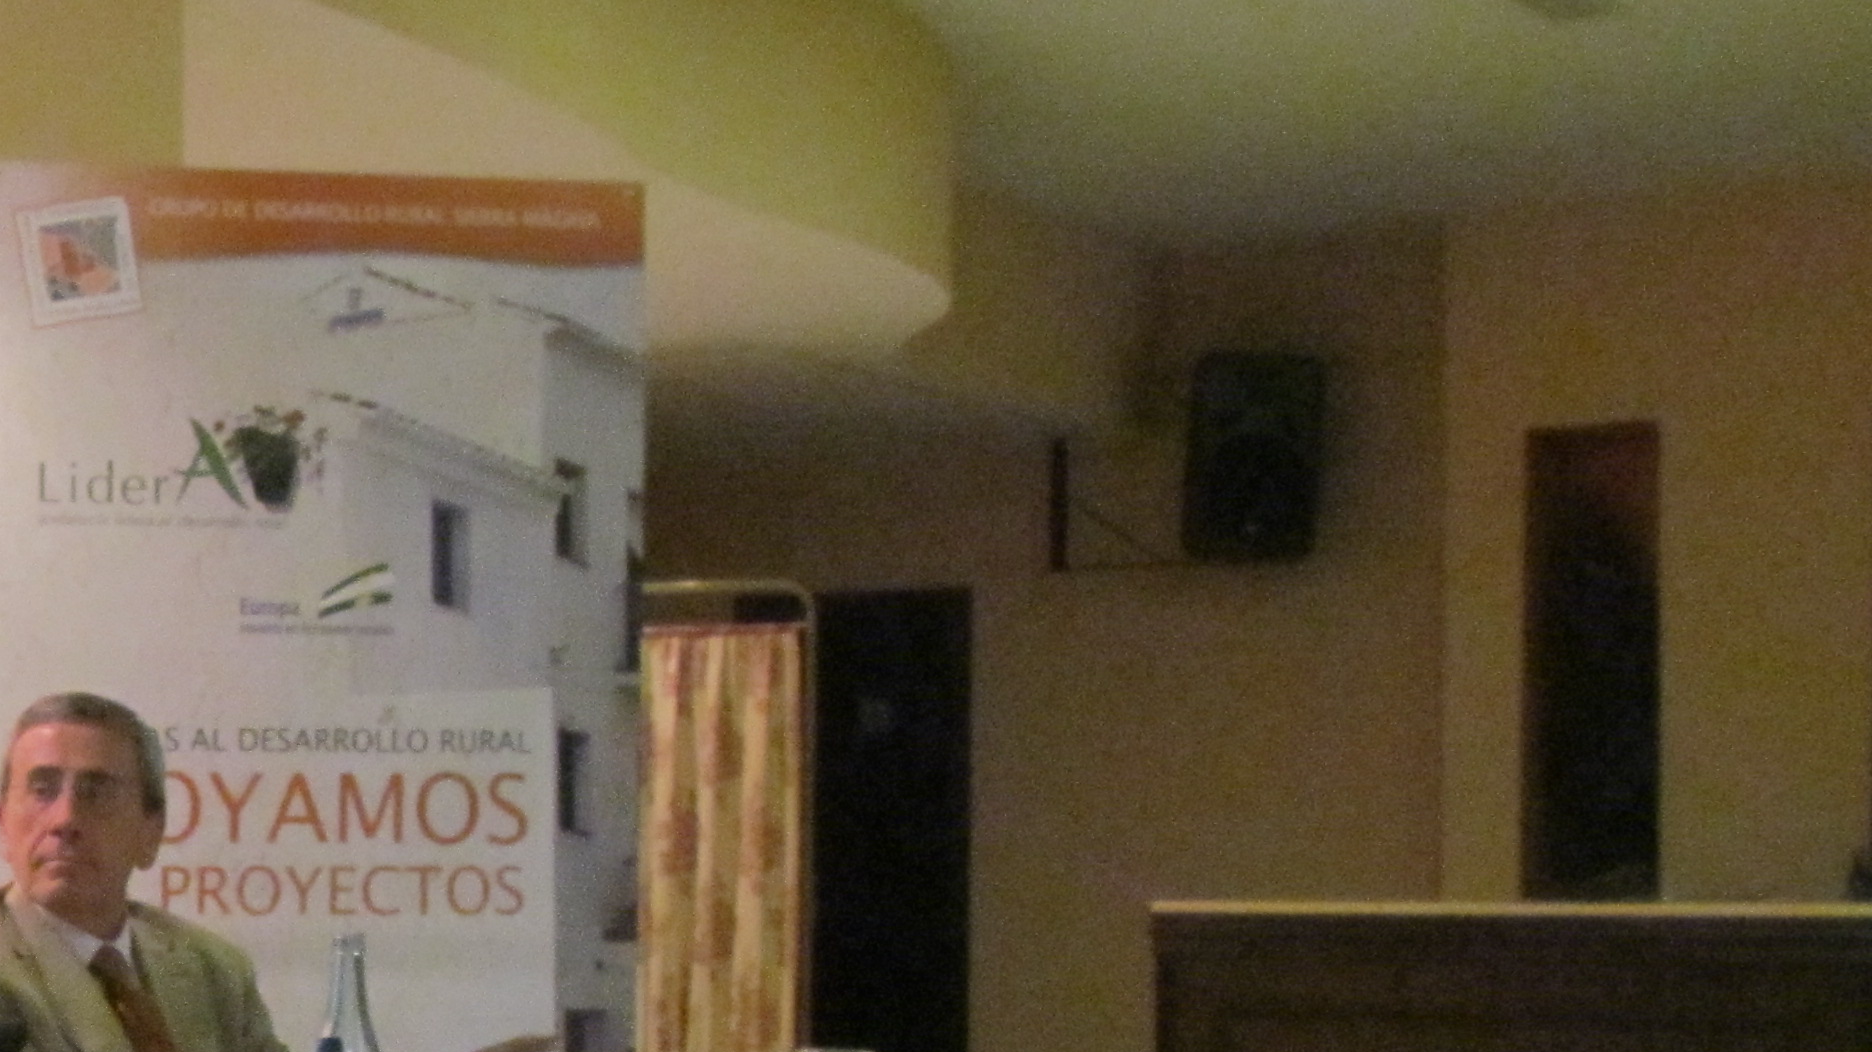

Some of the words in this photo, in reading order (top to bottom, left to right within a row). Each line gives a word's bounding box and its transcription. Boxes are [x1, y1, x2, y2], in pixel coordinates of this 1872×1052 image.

[190, 727, 227, 752] AL
[237, 727, 430, 754] DESARROLLO
[439, 728, 533, 755] RURAL
[162, 770, 529, 847] OYAMOS
[160, 864, 525, 917] PROYECTOS
